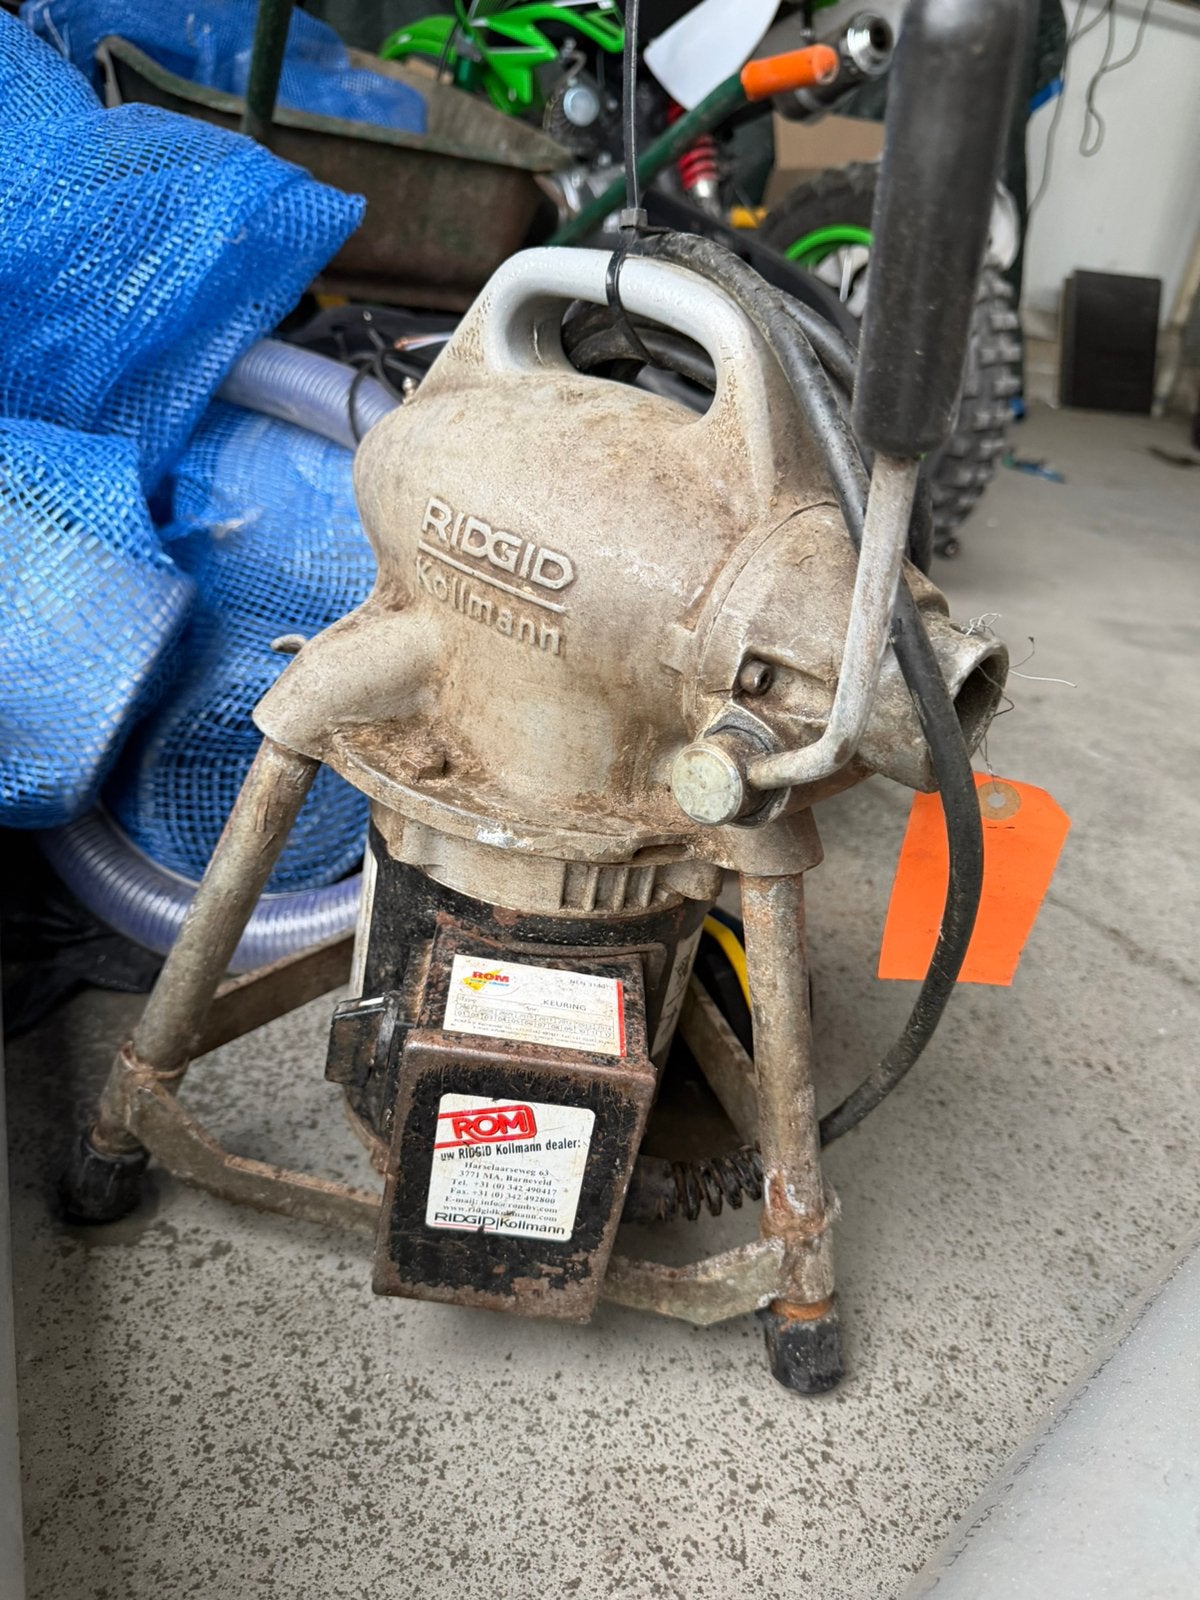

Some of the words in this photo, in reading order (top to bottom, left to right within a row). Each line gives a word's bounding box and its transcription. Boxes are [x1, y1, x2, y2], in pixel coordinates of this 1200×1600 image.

[422, 497, 575, 590] RIDGID
[416, 556, 562, 656] Kollmann
[472, 971, 510, 983] ROM
[543, 999, 587, 1011] KEURING
[452, 1111, 528, 1139] ROM
[440, 1152, 455, 1162] uw
[495, 1143, 542, 1156] Kollmann
[545, 1138, 581, 1151] dealer:
[459, 1170, 480, 1178] 3771
[451, 1178, 468, 1187] Tel.
[474, 1180, 489, 1189] +31
[492, 1183, 505, 1191] (0)
[490, 1192, 504, 1200] (0)
